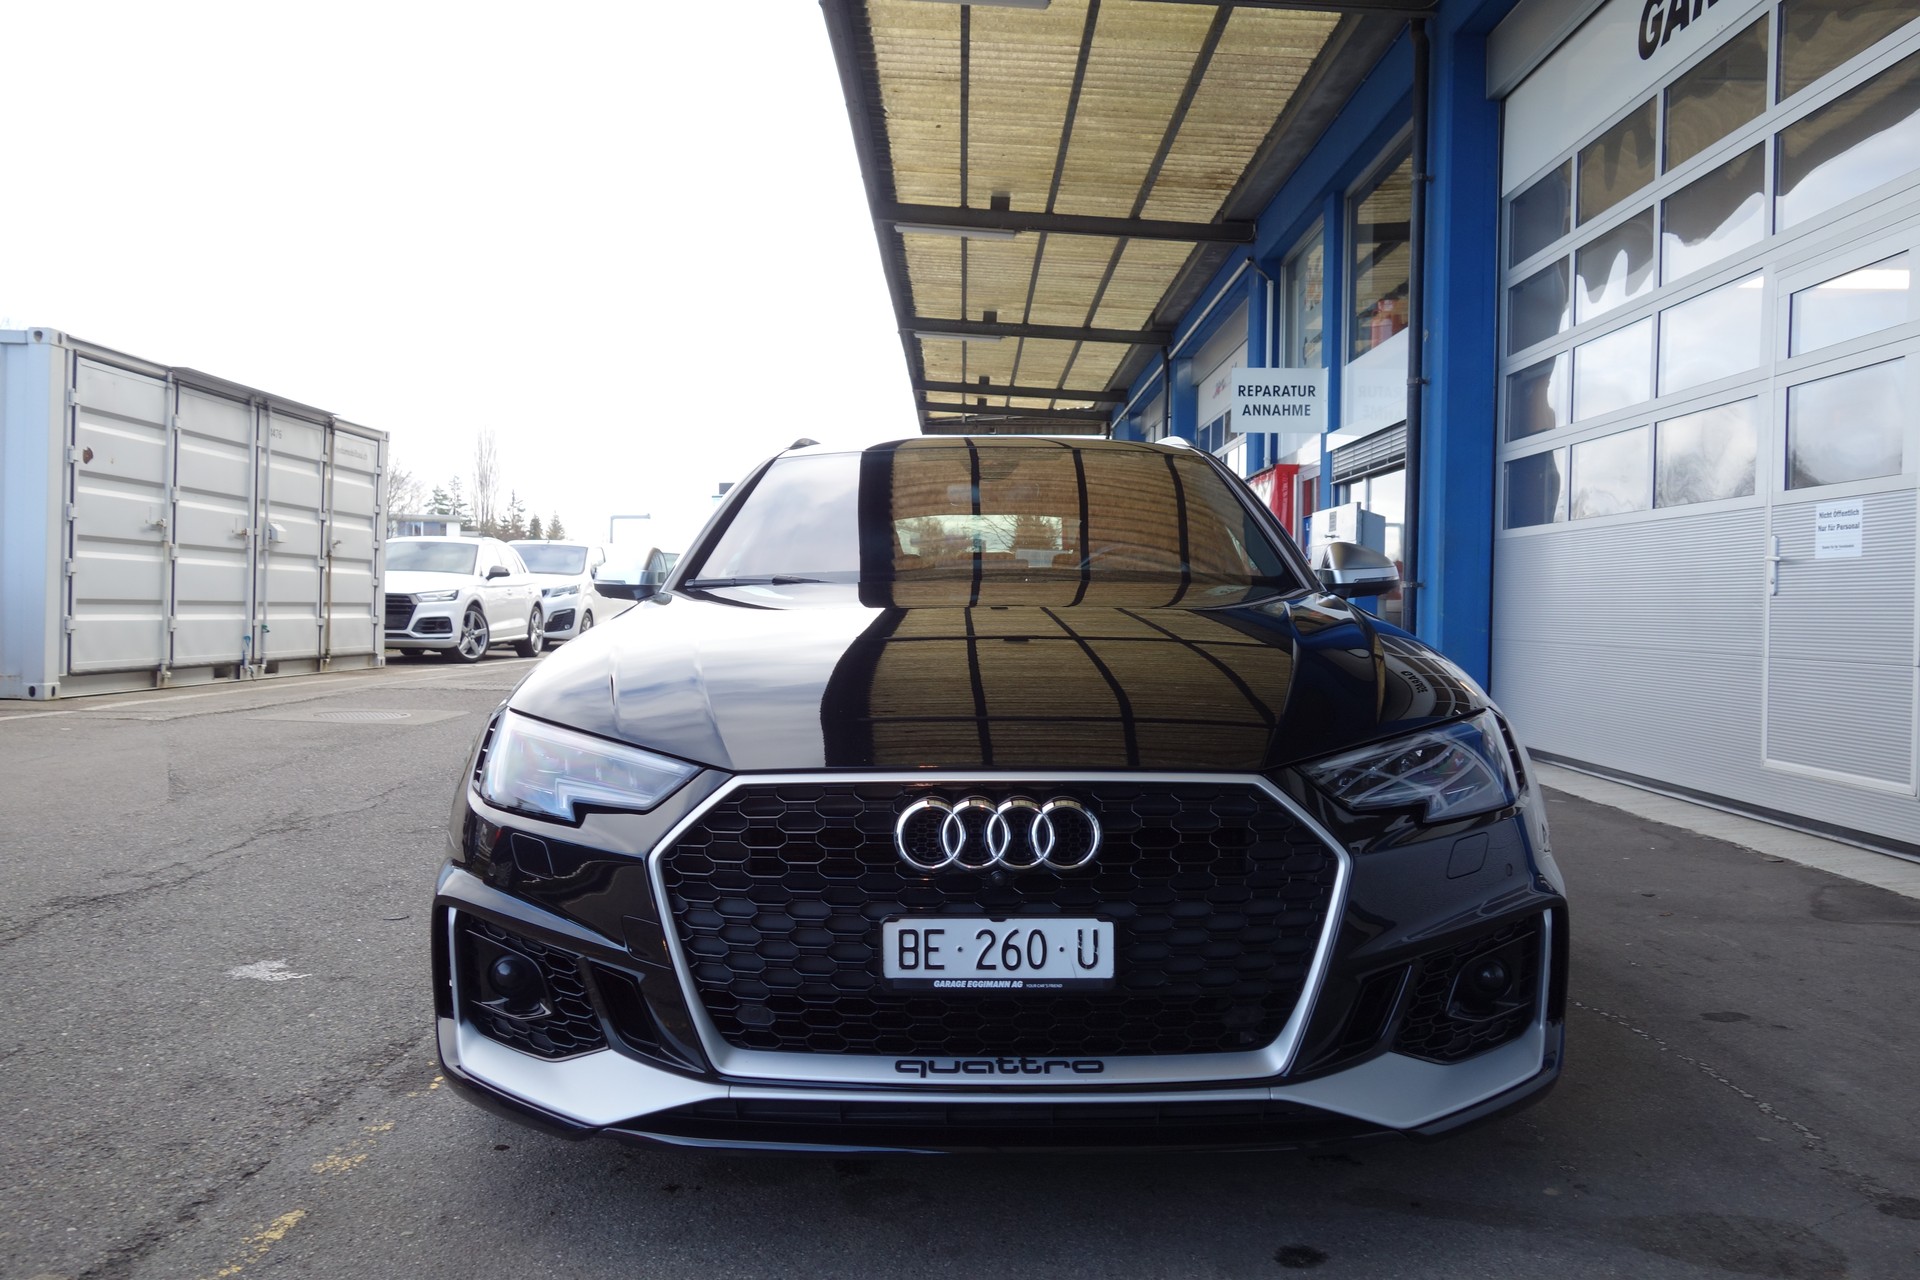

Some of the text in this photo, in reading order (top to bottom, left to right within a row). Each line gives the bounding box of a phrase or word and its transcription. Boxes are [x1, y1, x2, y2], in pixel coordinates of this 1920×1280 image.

[1237, 385, 1316, 397] REPARATUR
[1242, 404, 1311, 416] ANNAHME
[1819, 511, 1832, 519] Nicht
[1836, 522, 1860, 530] Personal
[898, 929, 1099, 971] BE 260 U
[933, 980, 967, 988] GARAGE
[966, 980, 1011, 988] EGGIMANN
[1011, 980, 1023, 988] AG
[895, 1057, 1105, 1078] quattro
